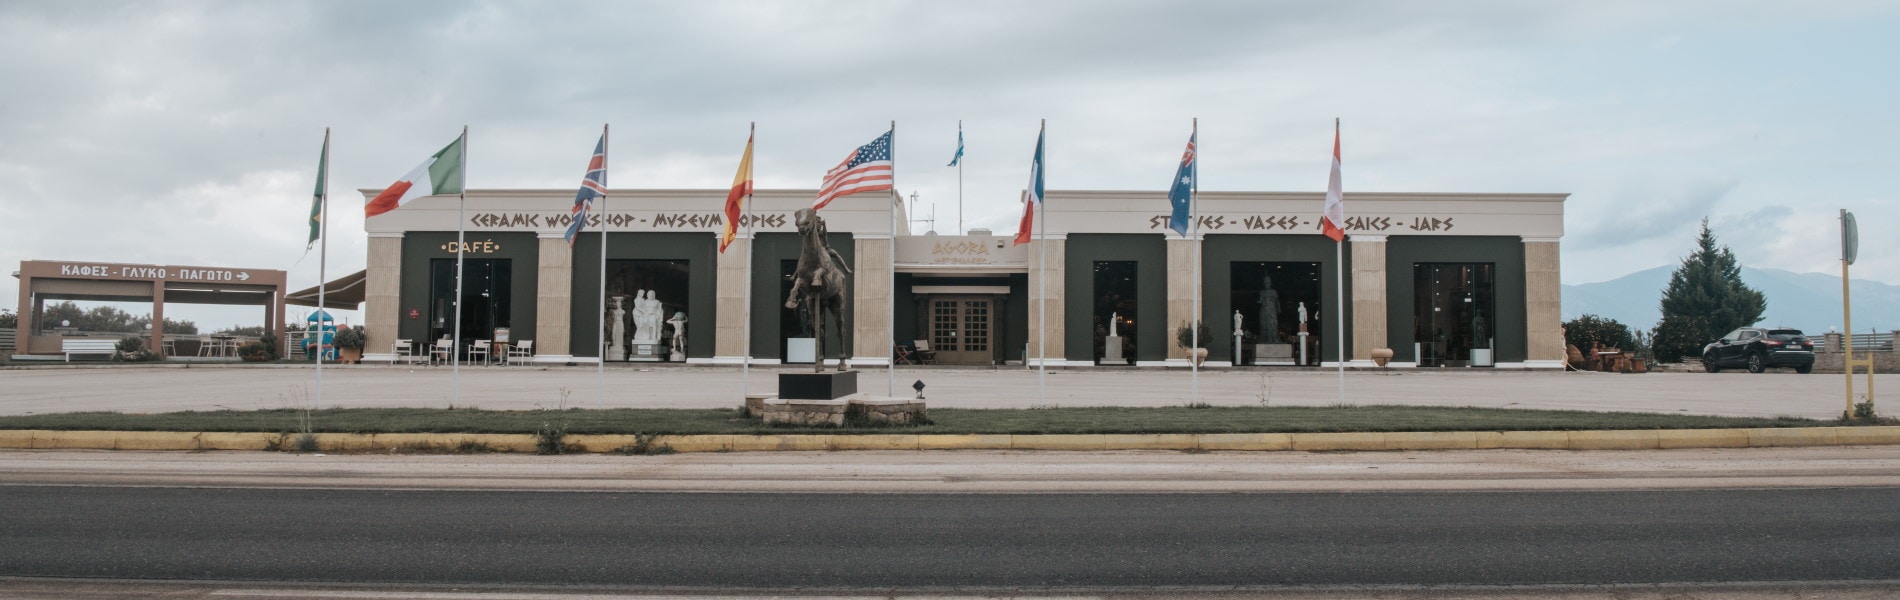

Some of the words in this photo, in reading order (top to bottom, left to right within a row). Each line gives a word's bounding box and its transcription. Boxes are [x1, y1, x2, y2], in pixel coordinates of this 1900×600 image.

[471, 213, 540, 228] CERAMIC
[545, 213, 636, 228] WOSHOP
[738, 213, 787, 228] OPIES
[1149, 215, 1224, 230] STES
[1243, 215, 1298, 230] VASES
[1316, 215, 1391, 231] SAICS
[1409, 216, 1454, 231] JARS
[931, 239, 990, 255] AGORA
[61, 264, 109, 277] ΚΑΦΕΣ
[122, 266, 166, 279] ΓΛΥΚΟ
[180, 269, 232, 281] ΠΑΓΩΤΟ
